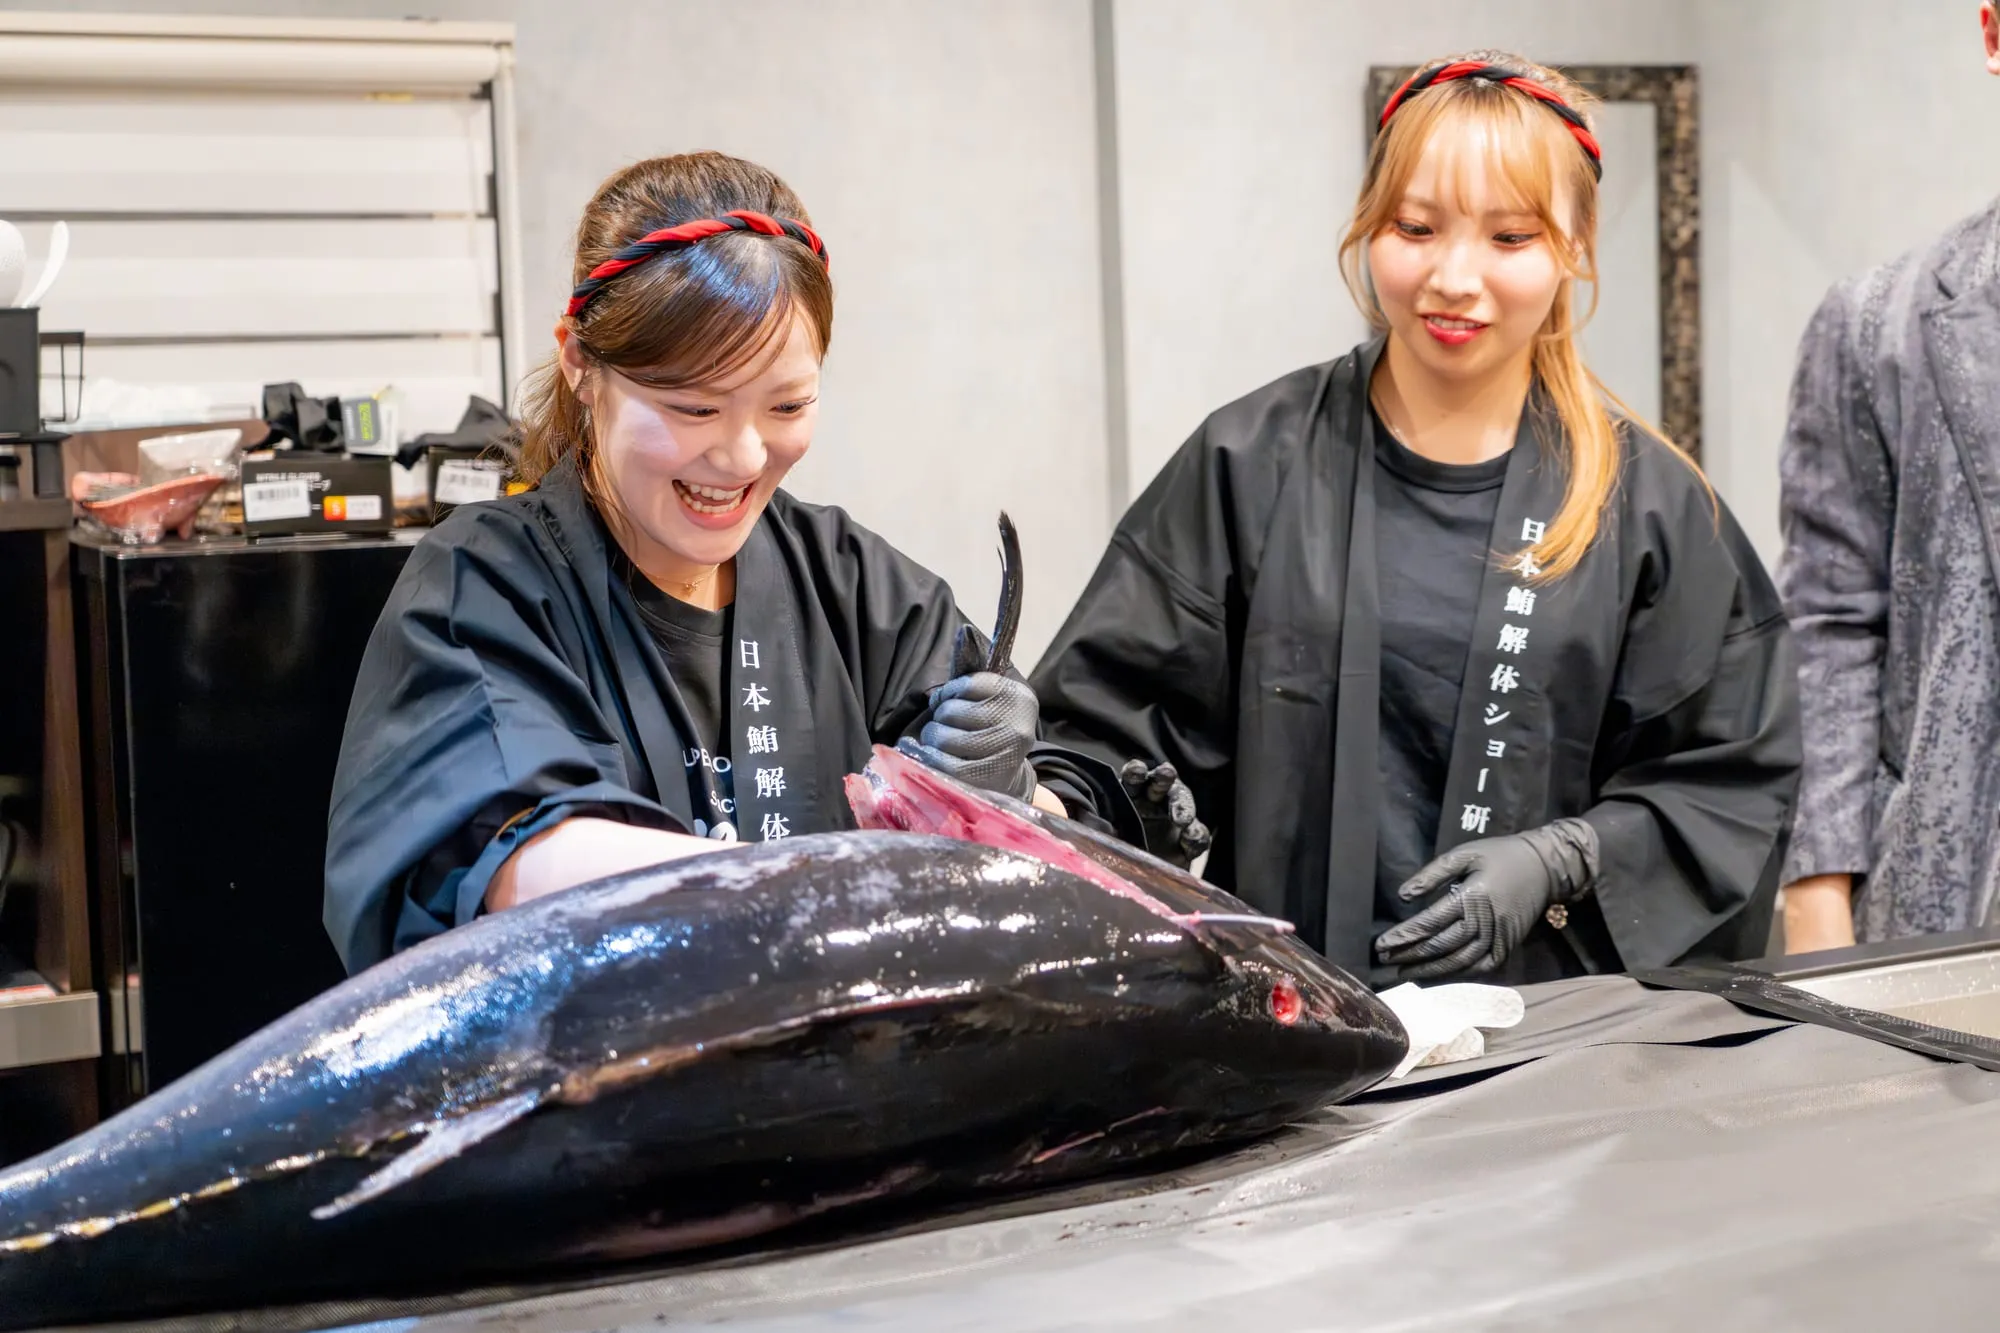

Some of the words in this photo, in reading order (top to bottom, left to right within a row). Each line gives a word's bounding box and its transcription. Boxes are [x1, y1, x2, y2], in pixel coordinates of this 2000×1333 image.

[740, 639, 790, 841] 日本鮪解体
